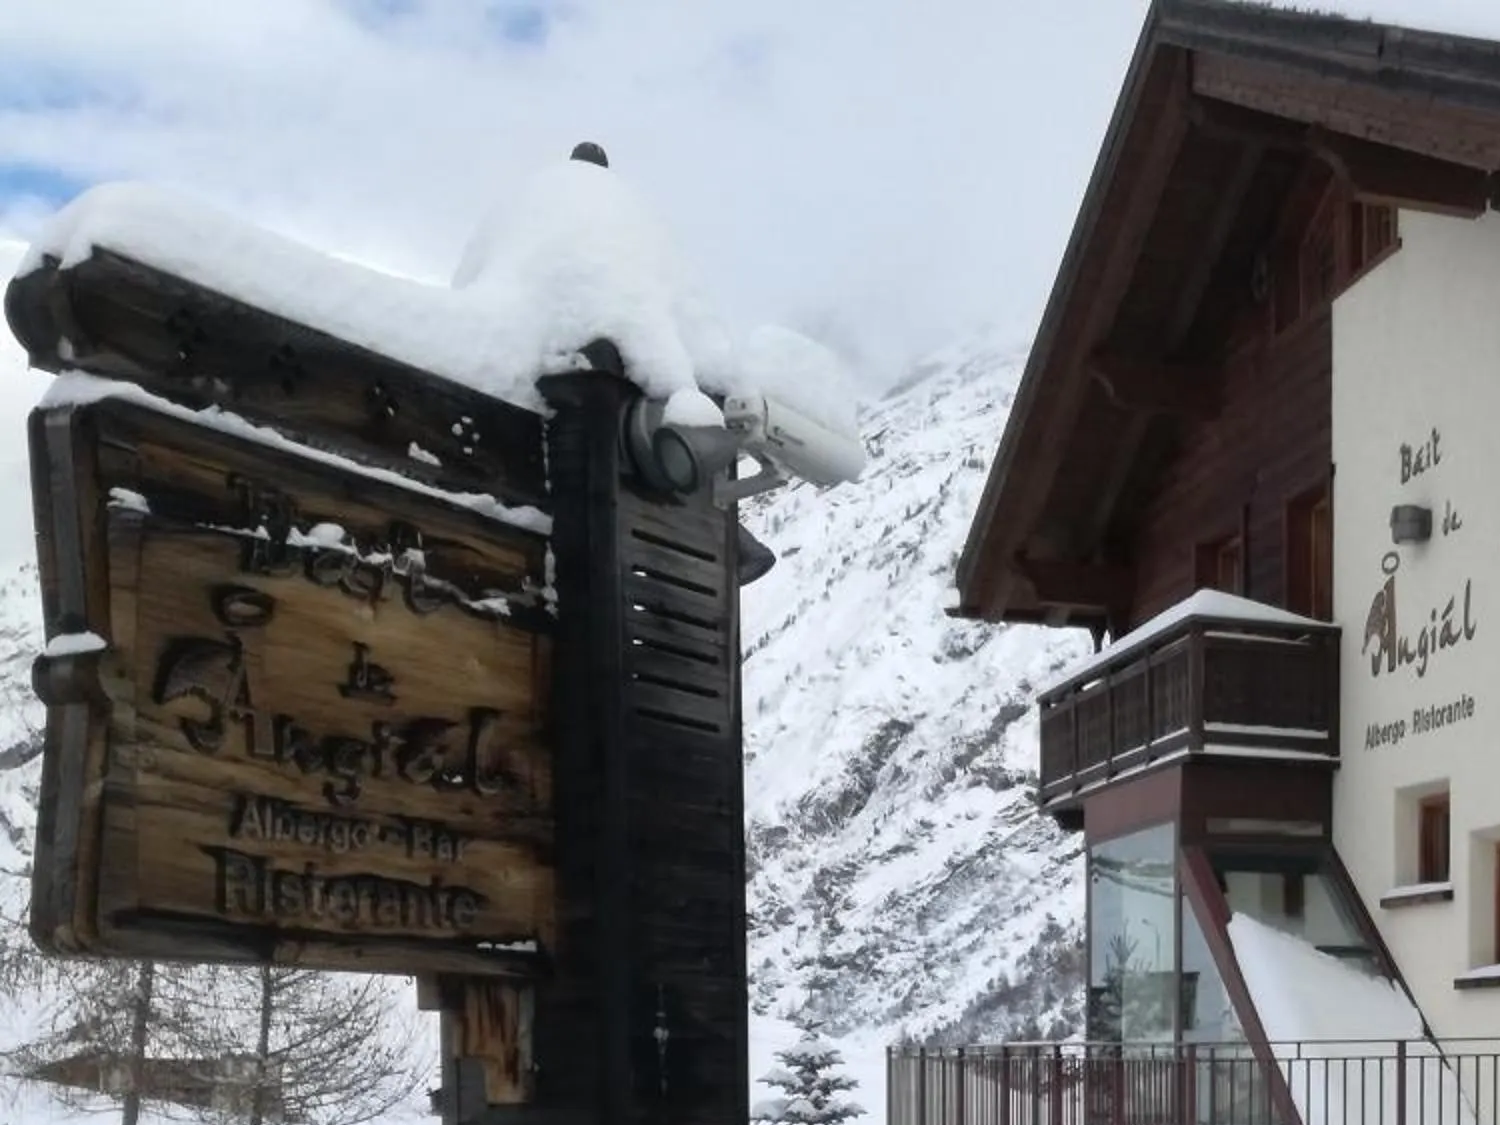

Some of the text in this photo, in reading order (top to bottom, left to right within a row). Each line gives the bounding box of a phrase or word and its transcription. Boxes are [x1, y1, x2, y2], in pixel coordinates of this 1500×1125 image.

[1364, 693, 1475, 751] Albergo Ristorante
[230, 794, 374, 855] Albergo
[406, 819, 470, 865] Bar
[214, 850, 488, 932] Ristorante
